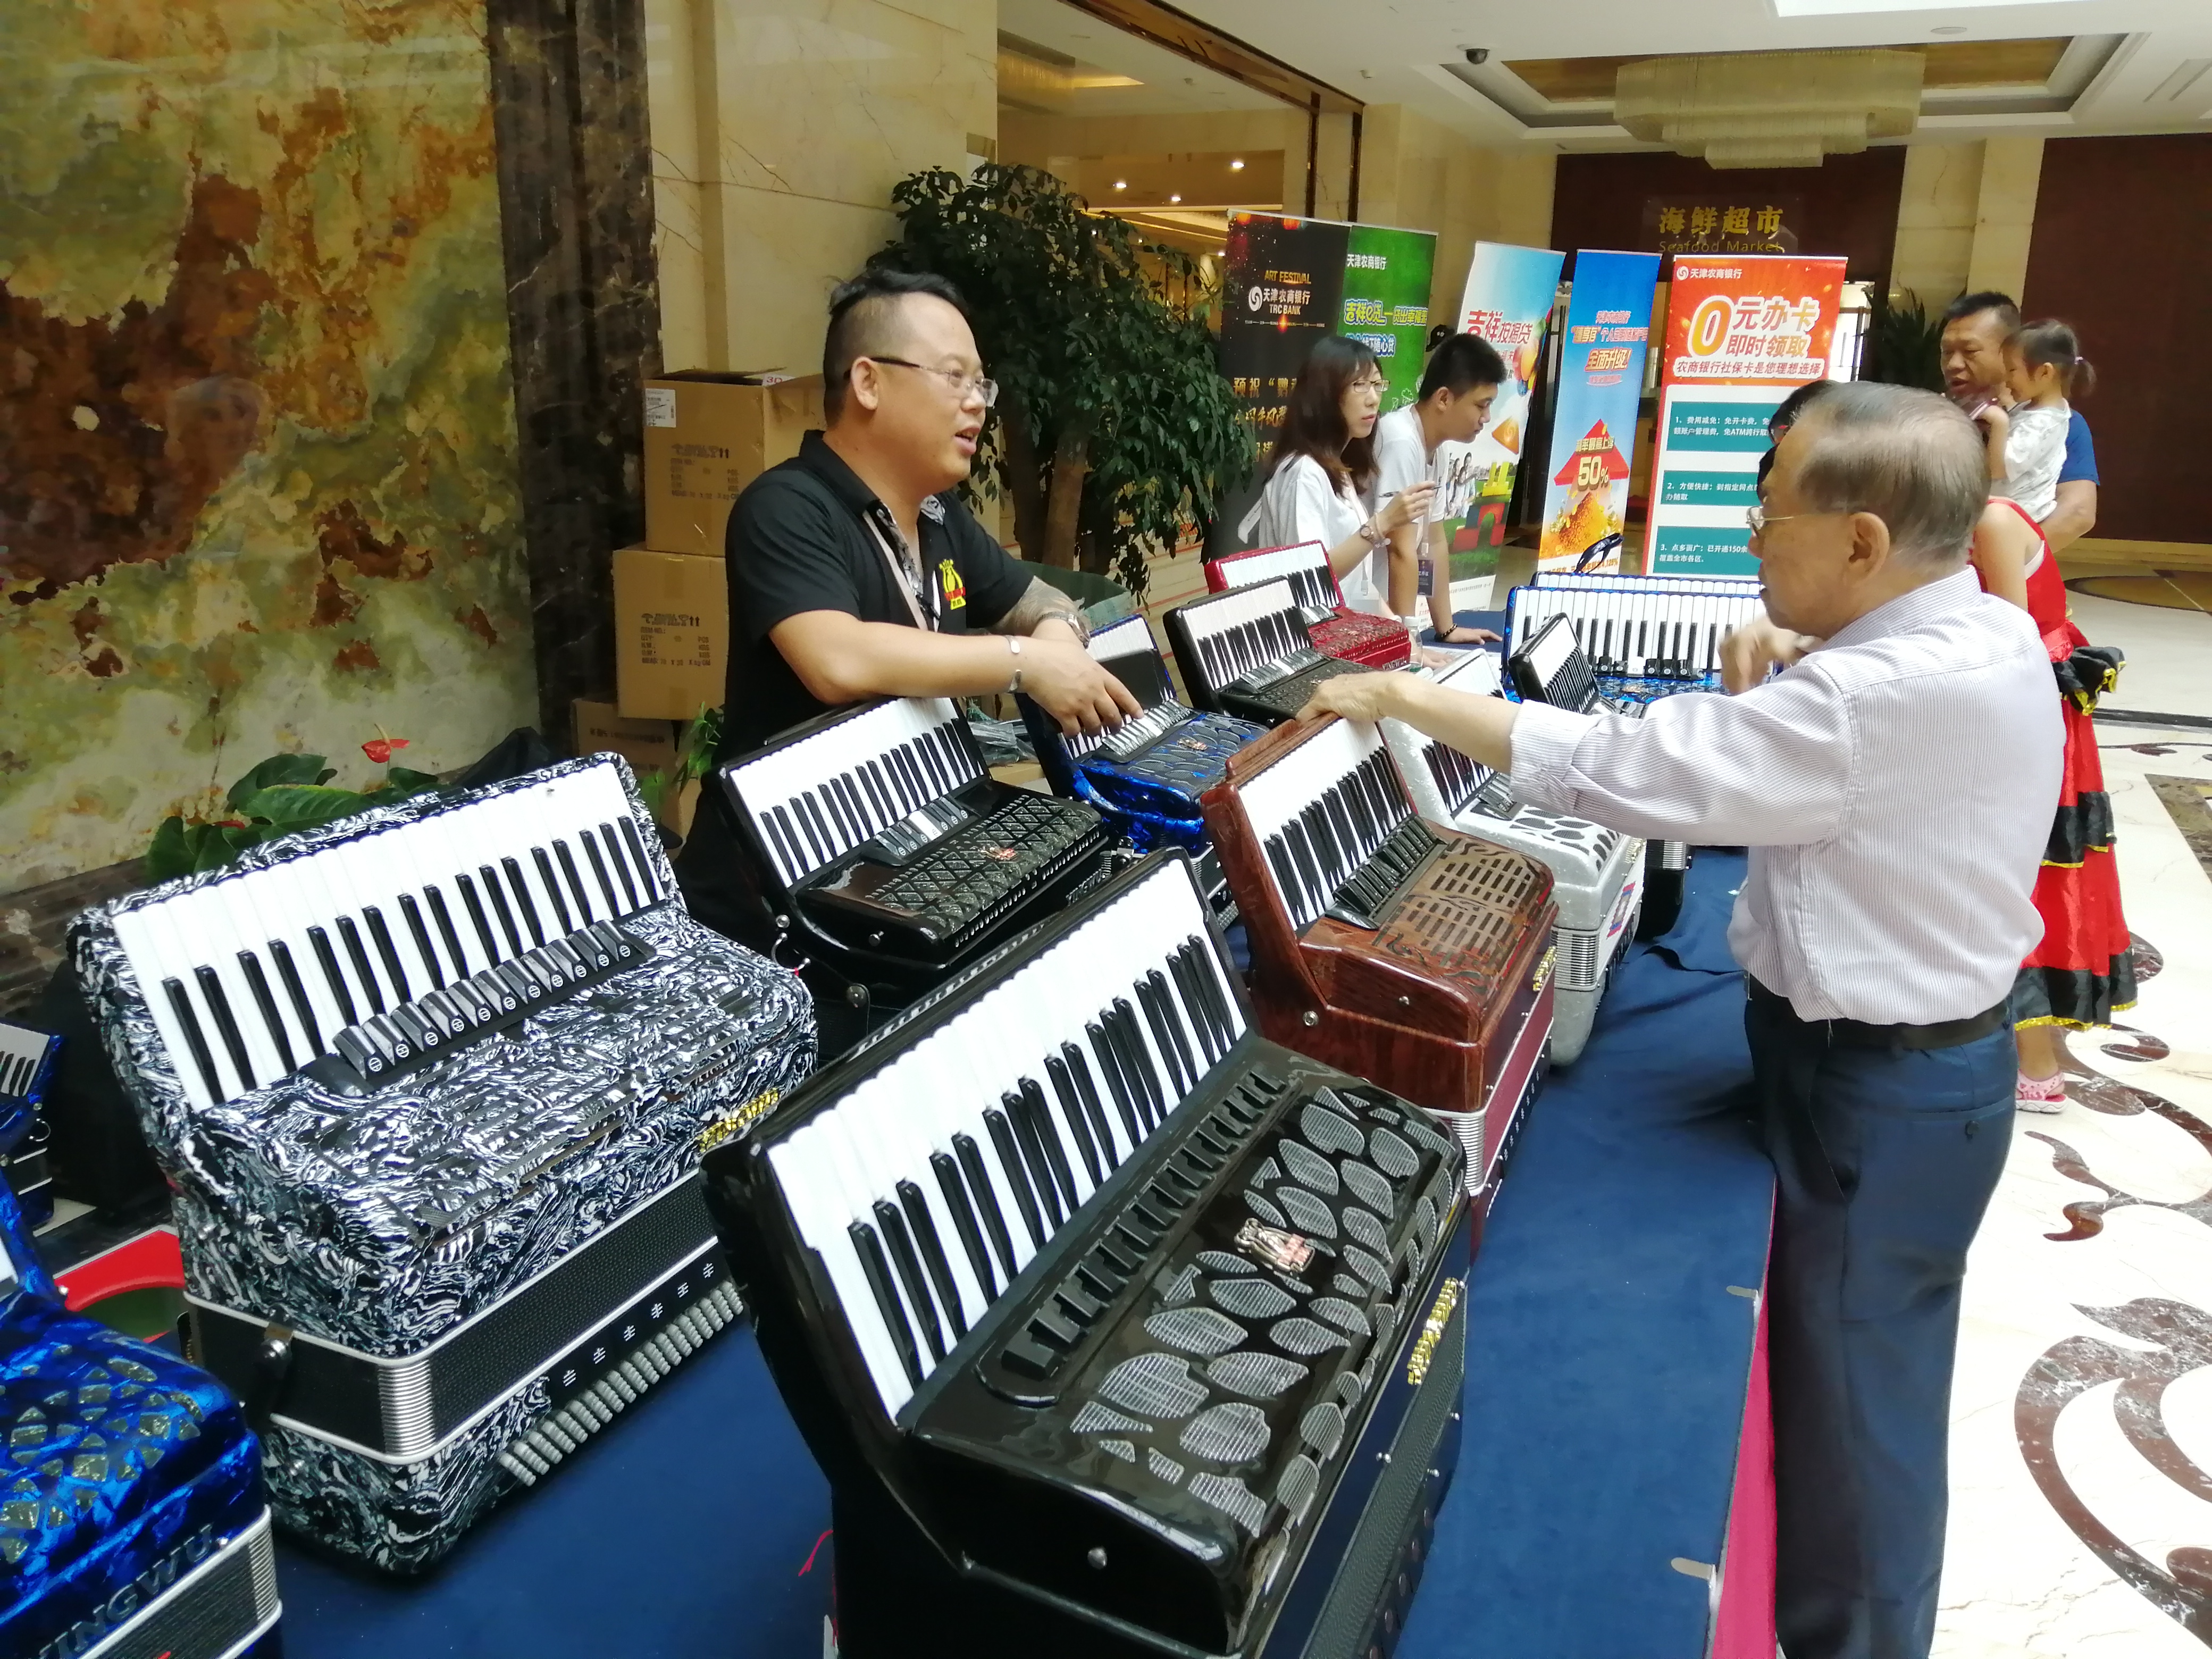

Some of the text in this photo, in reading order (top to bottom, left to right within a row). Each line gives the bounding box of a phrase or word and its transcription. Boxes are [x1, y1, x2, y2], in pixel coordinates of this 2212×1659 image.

[1660, 205, 1783, 234] 海鲜超市
[1659, 240, 1783, 252] Seafood Market
[1347, 254, 1387, 270] 天津农商银行
[1264, 270, 1312, 284] ART FESTIVAL
[1690, 269, 1742, 279] 天津农商银行
[1263, 288, 1310, 305] 天津农商银行
[1269, 304, 1301, 315] TRC BANK
[1467, 310, 1532, 344] 吉祥按揭贷
[1726, 334, 1808, 357] 即时领取
[1677, 361, 1821, 375] 农商银行社保卡是您理想选择
[1578, 455, 1610, 491] 50%
